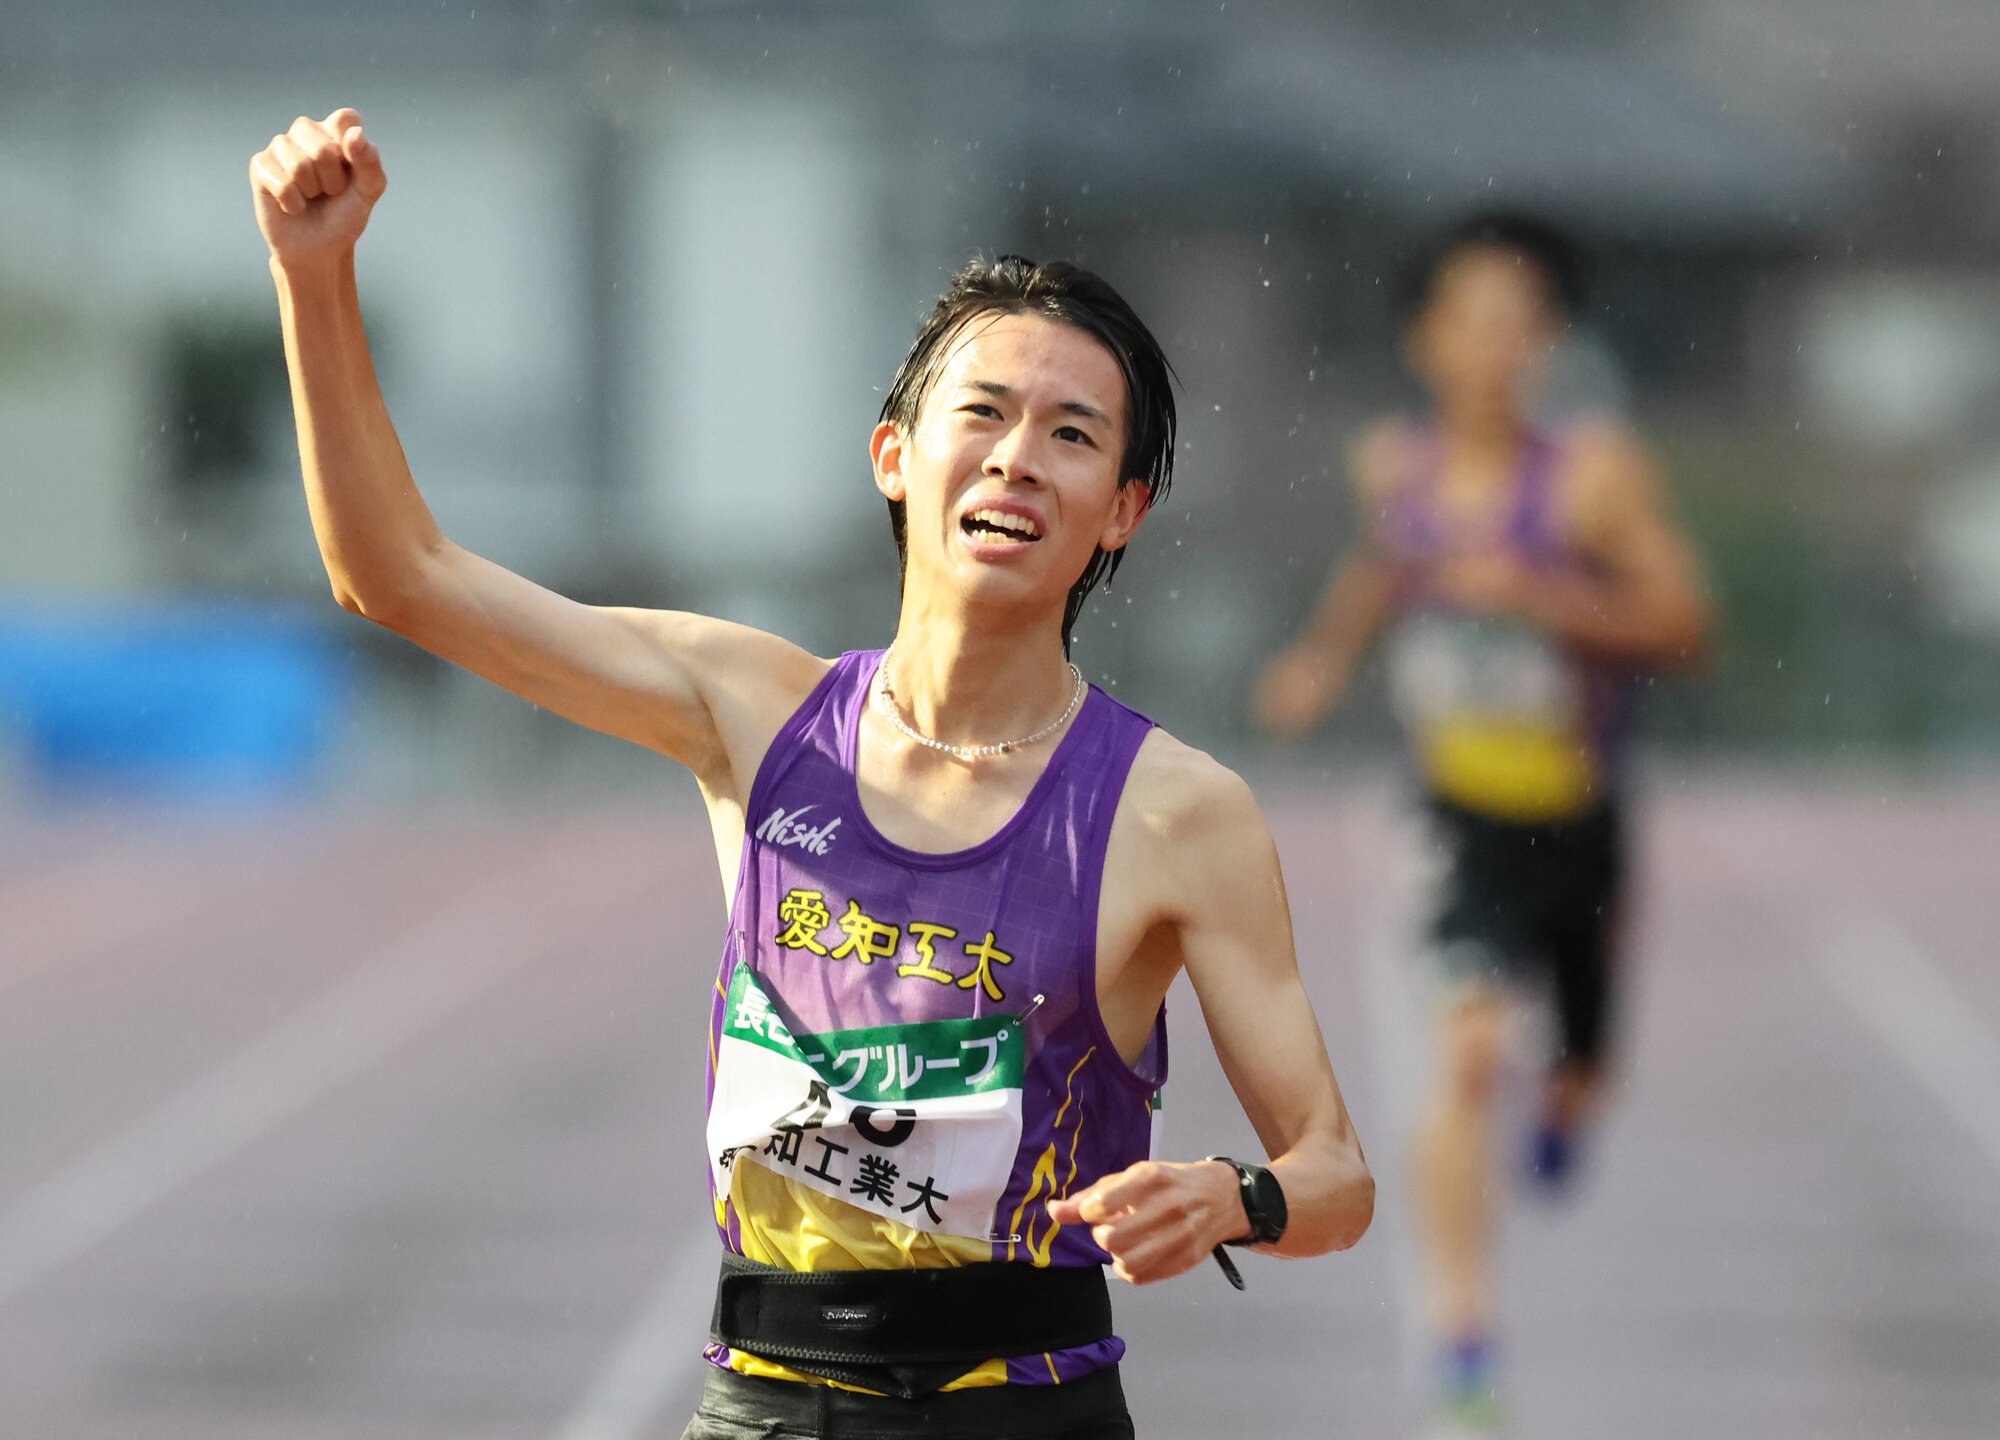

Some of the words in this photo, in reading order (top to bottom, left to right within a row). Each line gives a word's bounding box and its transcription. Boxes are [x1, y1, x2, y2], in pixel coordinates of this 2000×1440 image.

[775, 887, 1013, 1002] 愛知工大
[734, 984, 1009, 1094] 長グループ
